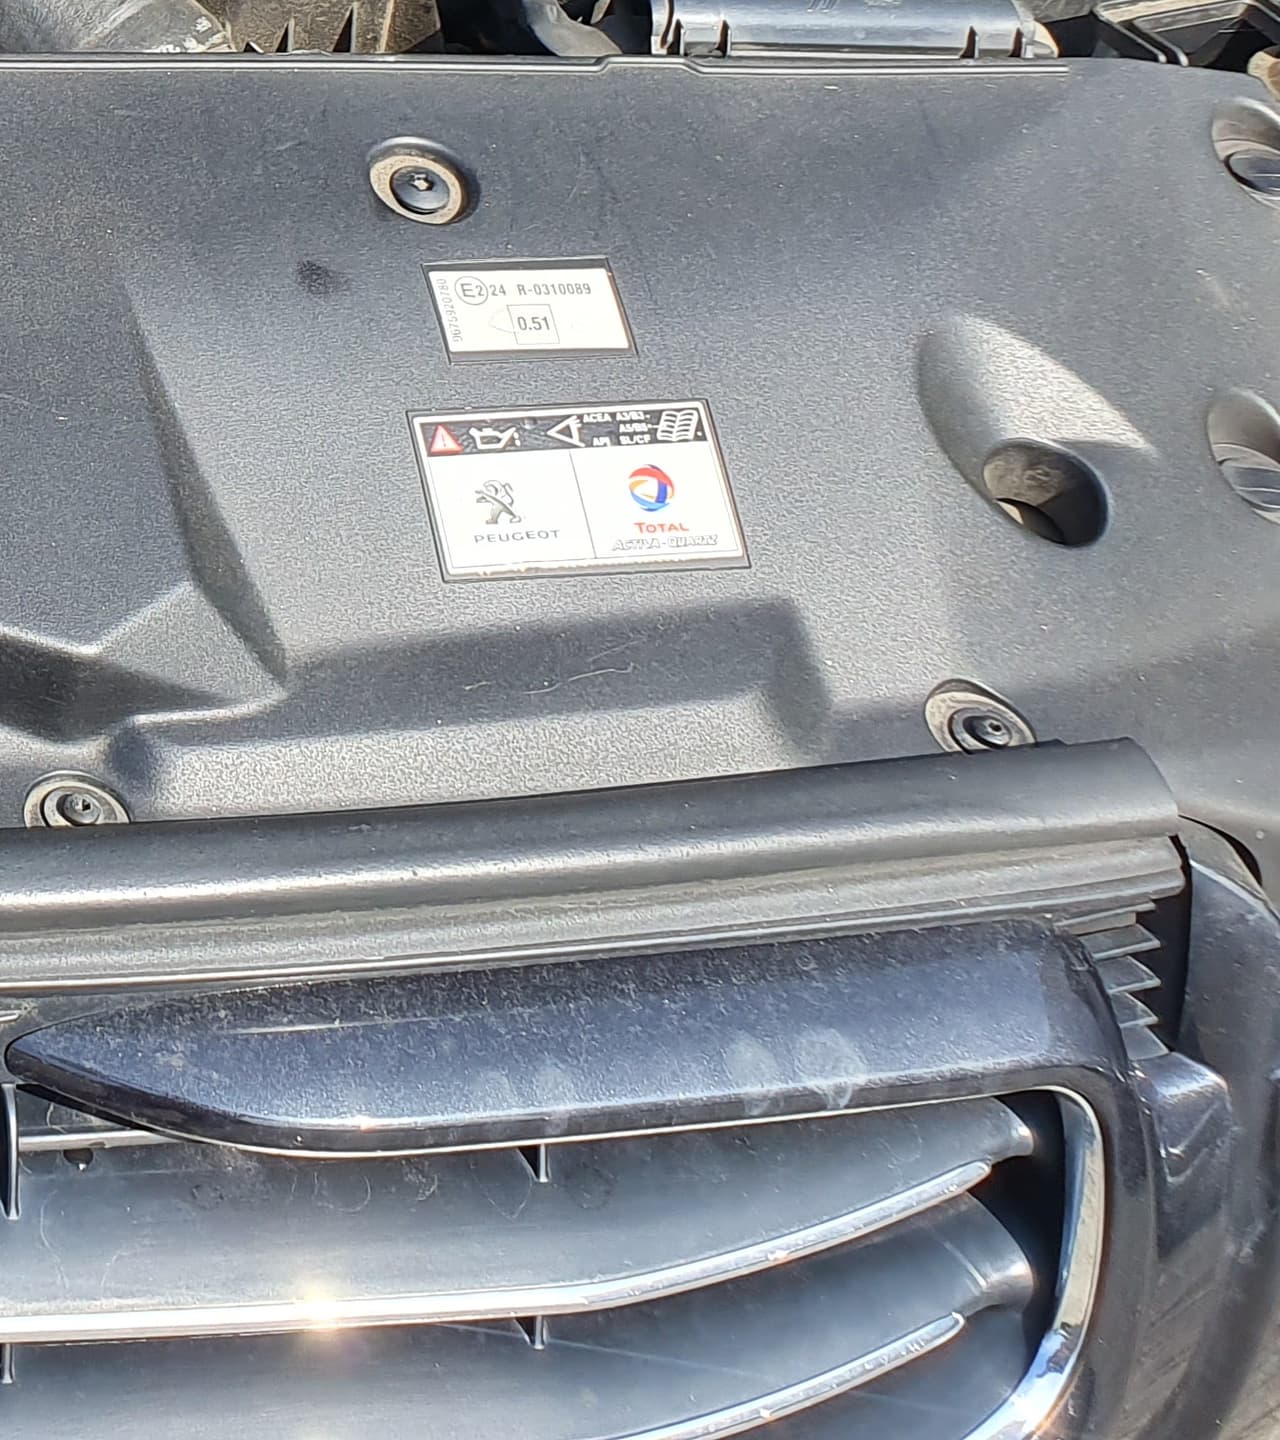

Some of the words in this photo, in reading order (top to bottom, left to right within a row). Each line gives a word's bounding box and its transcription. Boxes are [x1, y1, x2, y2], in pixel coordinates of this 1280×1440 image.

[492, 284, 506, 297] 24
[518, 283, 592, 296] R-0310089
[517, 317, 552, 332] 0.51
[634, 522, 690, 534] TOTAL
[474, 528, 560, 544] PEUGEOT
